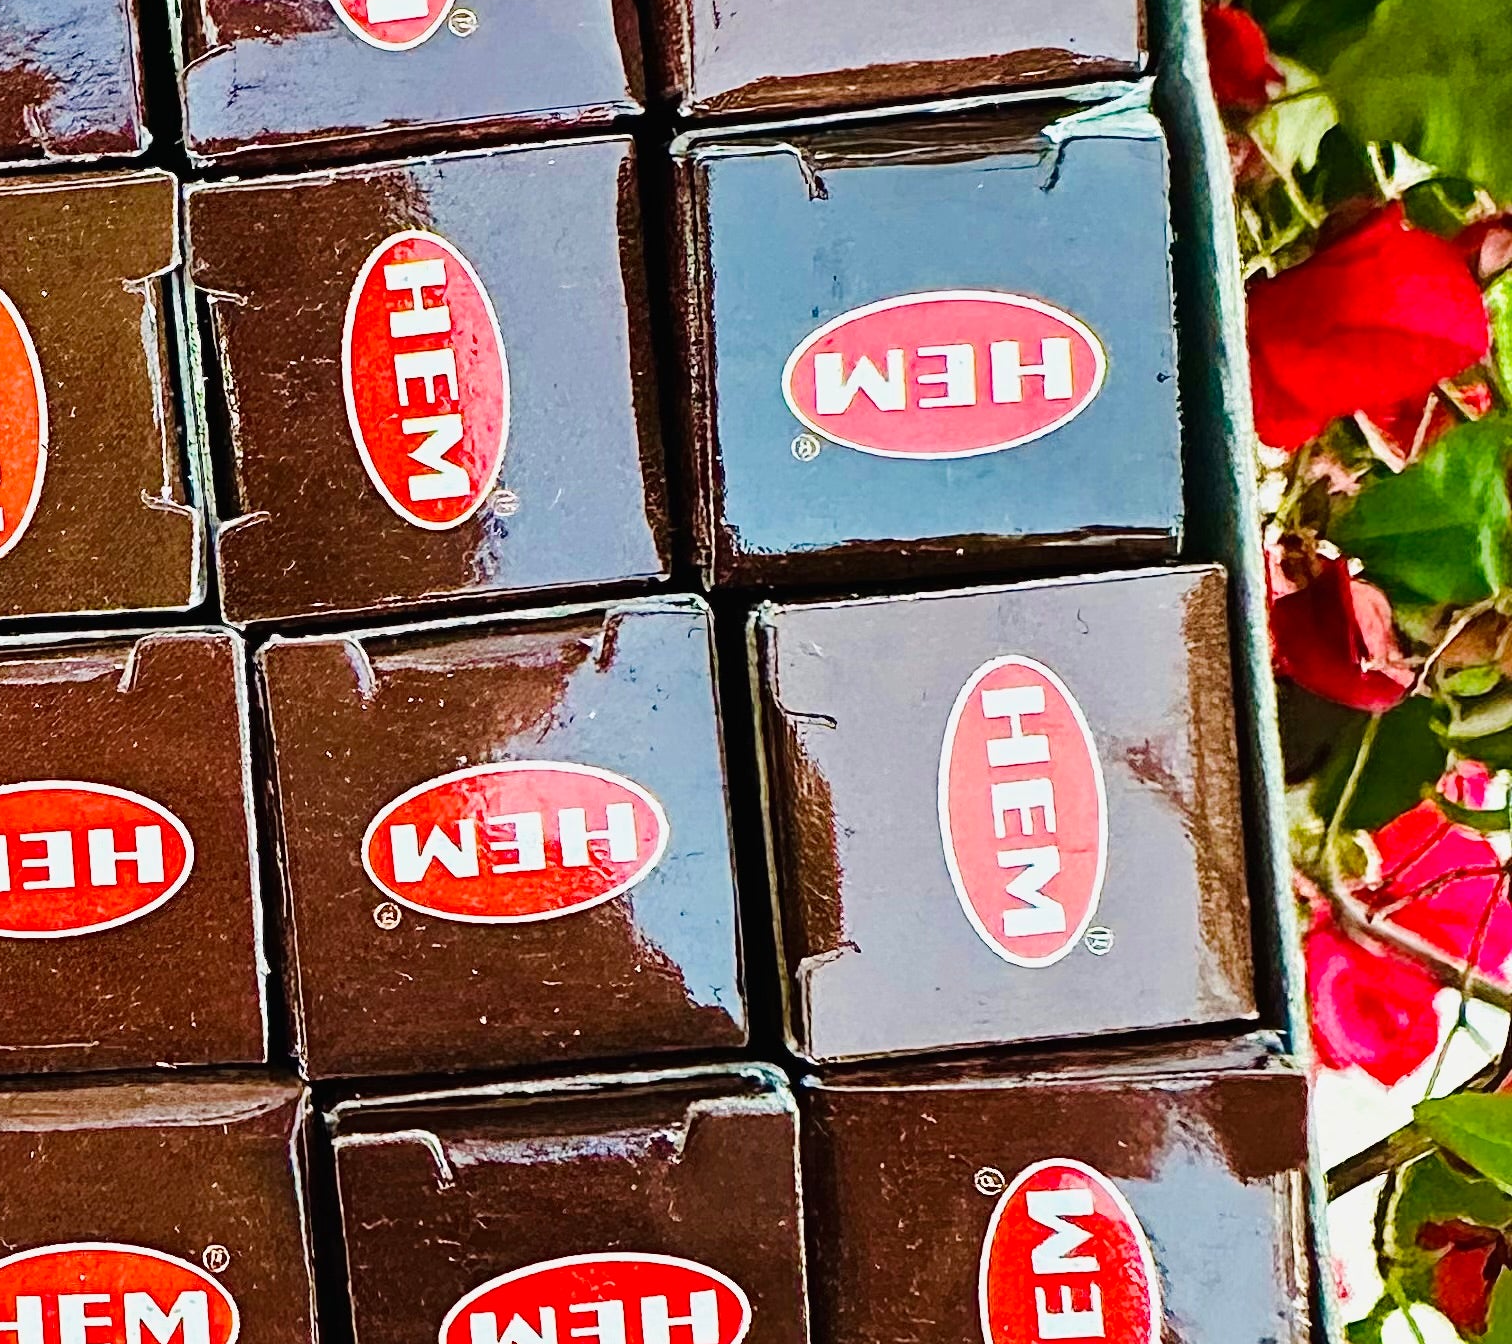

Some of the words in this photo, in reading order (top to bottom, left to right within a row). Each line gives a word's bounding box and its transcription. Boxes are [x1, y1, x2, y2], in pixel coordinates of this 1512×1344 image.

[384, 260, 469, 500] HEM
[815, 338, 1072, 414] HEM
[391, 803, 637, 882] HEM
[982, 686, 1066, 936] HEM
